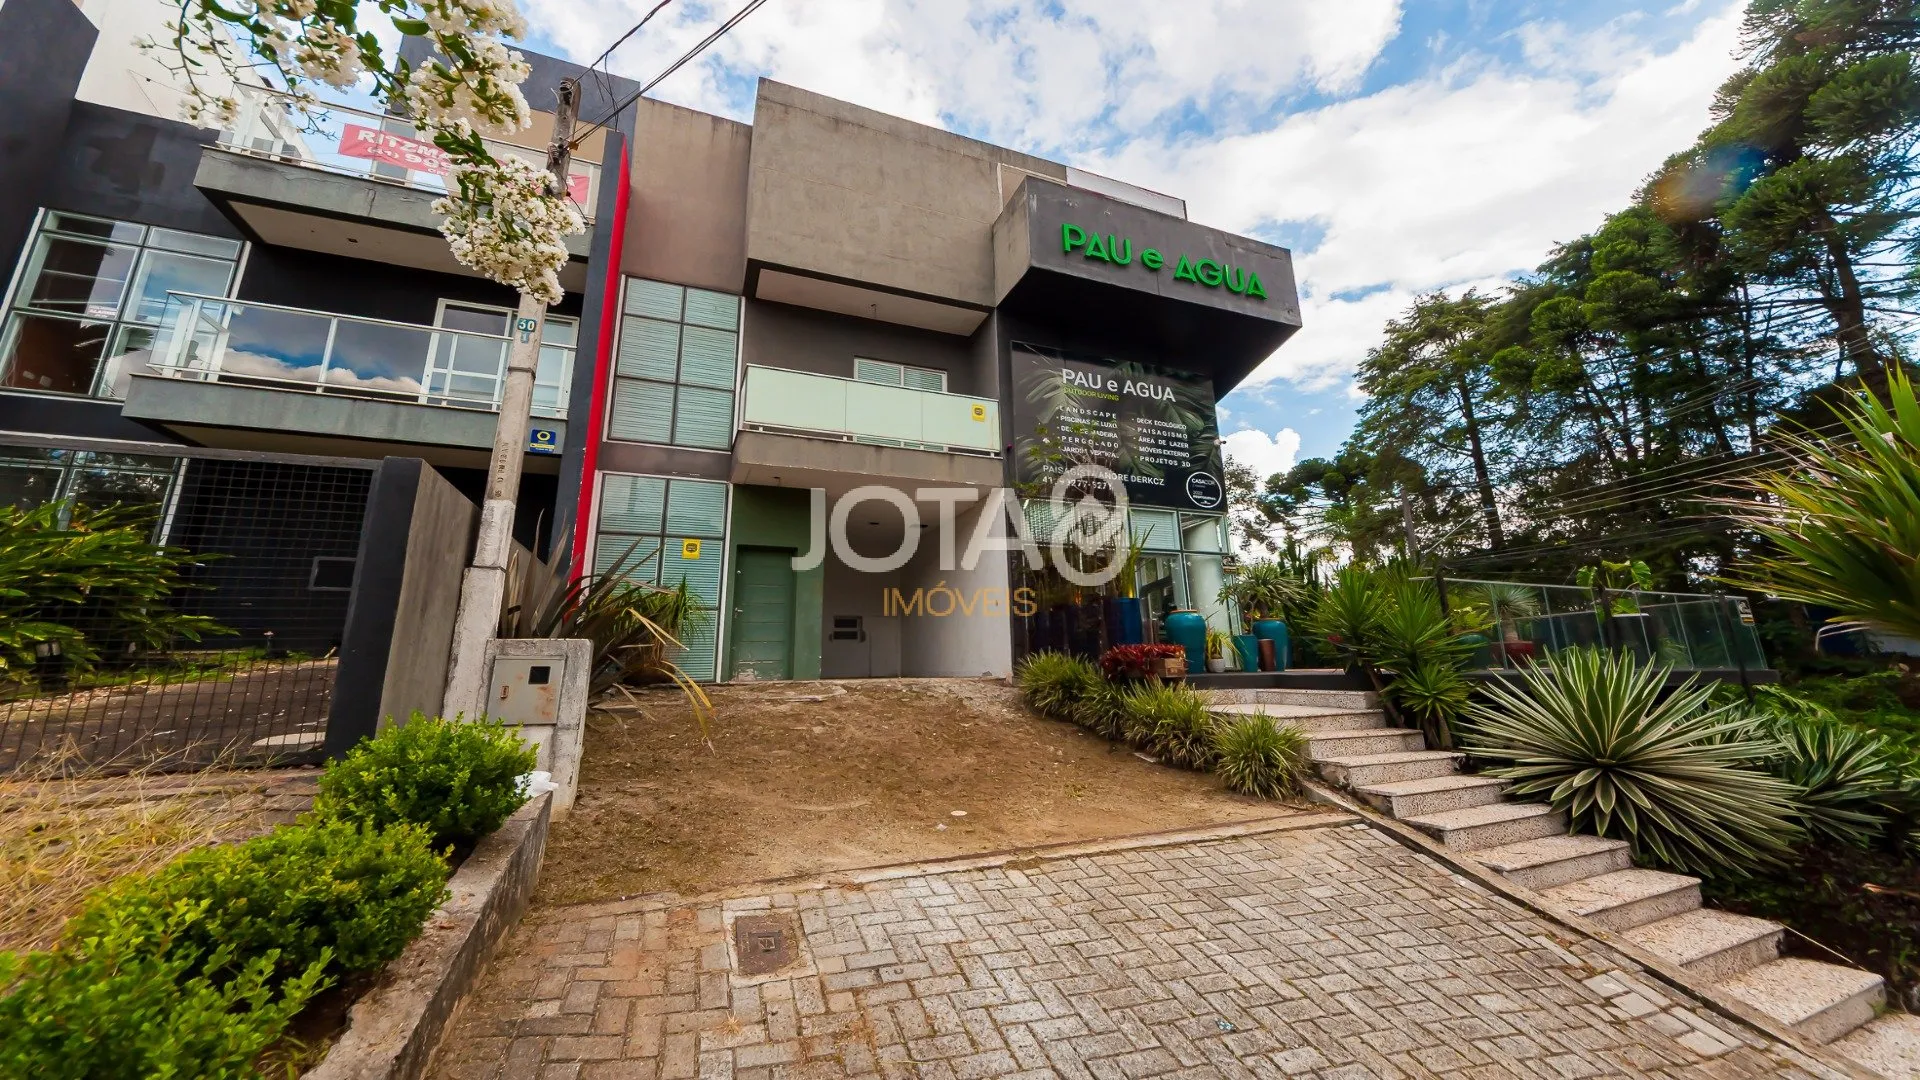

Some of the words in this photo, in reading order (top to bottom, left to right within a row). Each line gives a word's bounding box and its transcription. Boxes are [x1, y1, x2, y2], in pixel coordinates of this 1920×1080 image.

[1061, 223, 1132, 266] PAU
[1141, 248, 1164, 271] e
[1173, 254, 1268, 300] AGUA
[1061, 368, 1102, 389] PAU
[1107, 380, 1118, 392] e
[1122, 380, 1176, 402] AGUA
[1063, 386, 1096, 397] OUTDOOR
[1097, 392, 1120, 401] LIVING
[1060, 405, 1117, 419] LANDSCAPE
[1061, 415, 1090, 425] PISCINAS
[1101, 420, 1118, 429] LUXO
[1136, 417, 1153, 425] DECK
[1137, 427, 1188, 439] PAISAGISMO
[1061, 435, 1119, 449] PERGOLADO
[1138, 435, 1156, 444] ÁREA
[1169, 441, 1189, 449] LAZER
[1140, 456, 1178, 466] PROJETOS
[1130, 475, 1165, 486] DERKCZ
